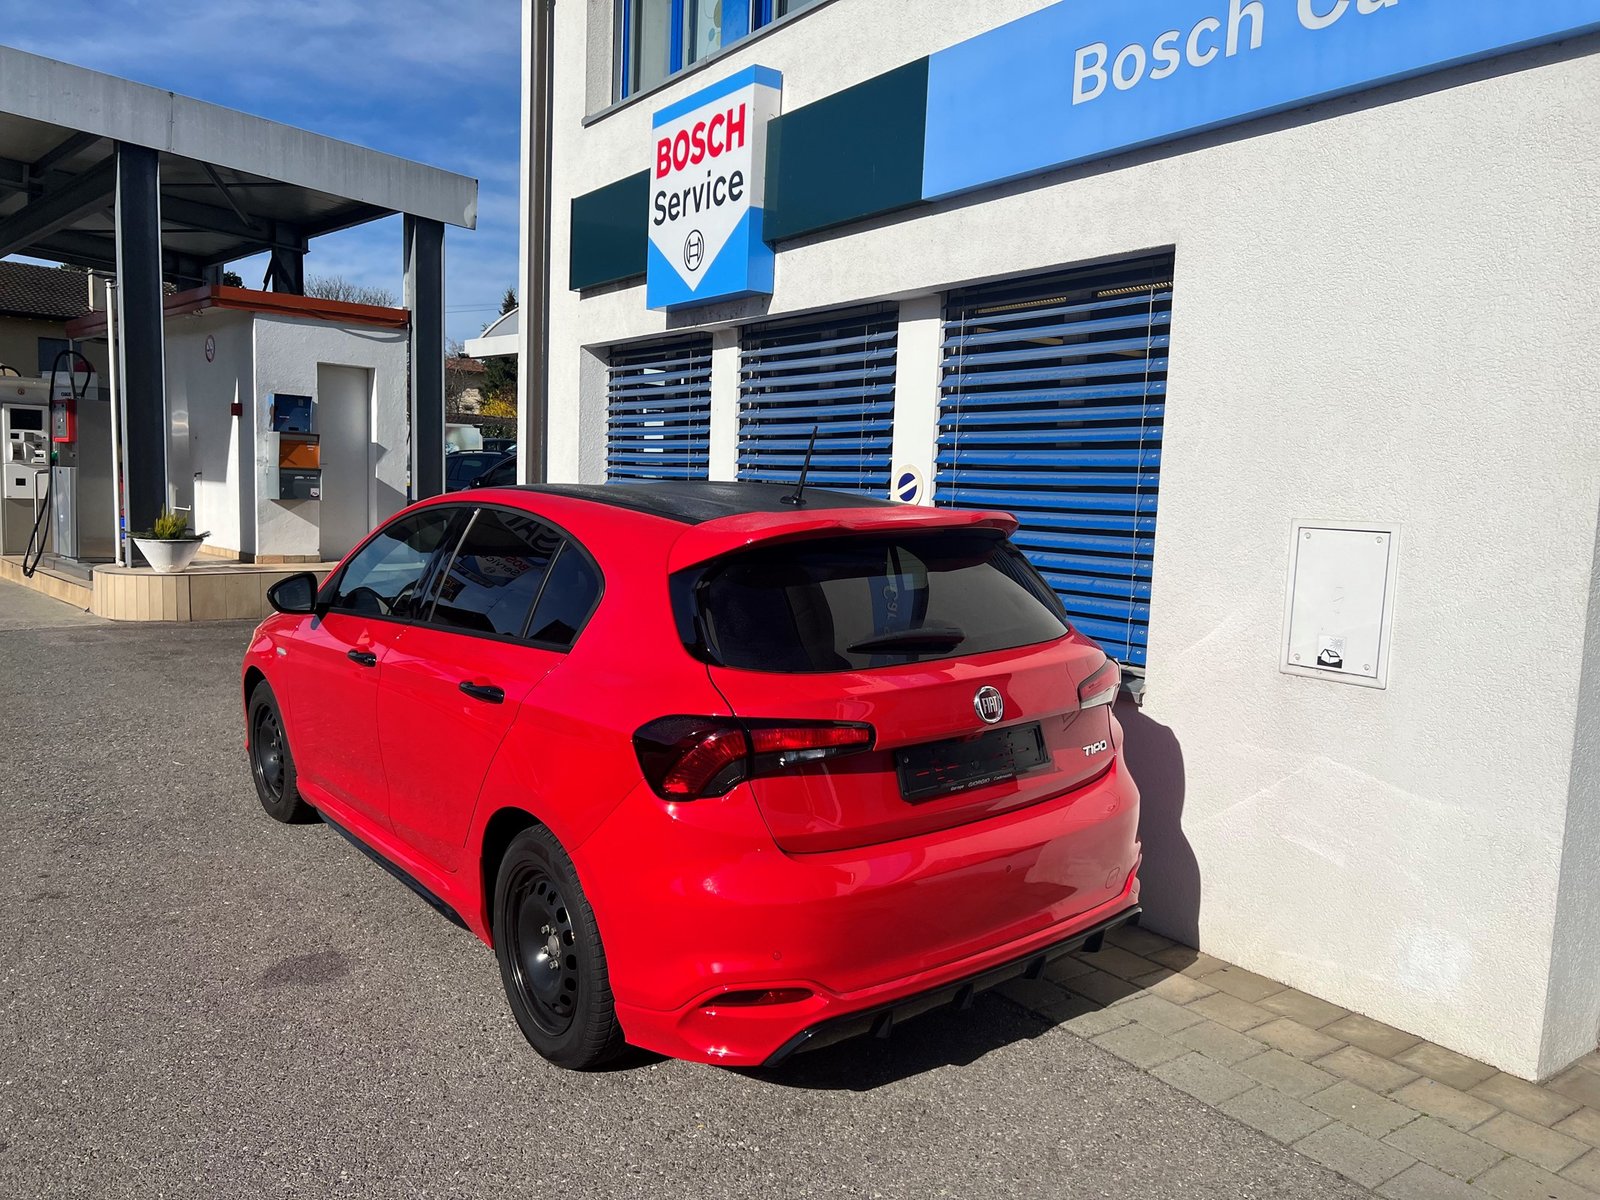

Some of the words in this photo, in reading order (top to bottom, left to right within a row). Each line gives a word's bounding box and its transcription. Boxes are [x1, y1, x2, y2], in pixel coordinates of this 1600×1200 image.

[1072, 0, 1264, 105] Bosch
[656, 103, 746, 180] BOSCH
[653, 170, 744, 226] Service
[981, 695, 998, 714] FIAT
[1082, 740, 1107, 756] TIPO
